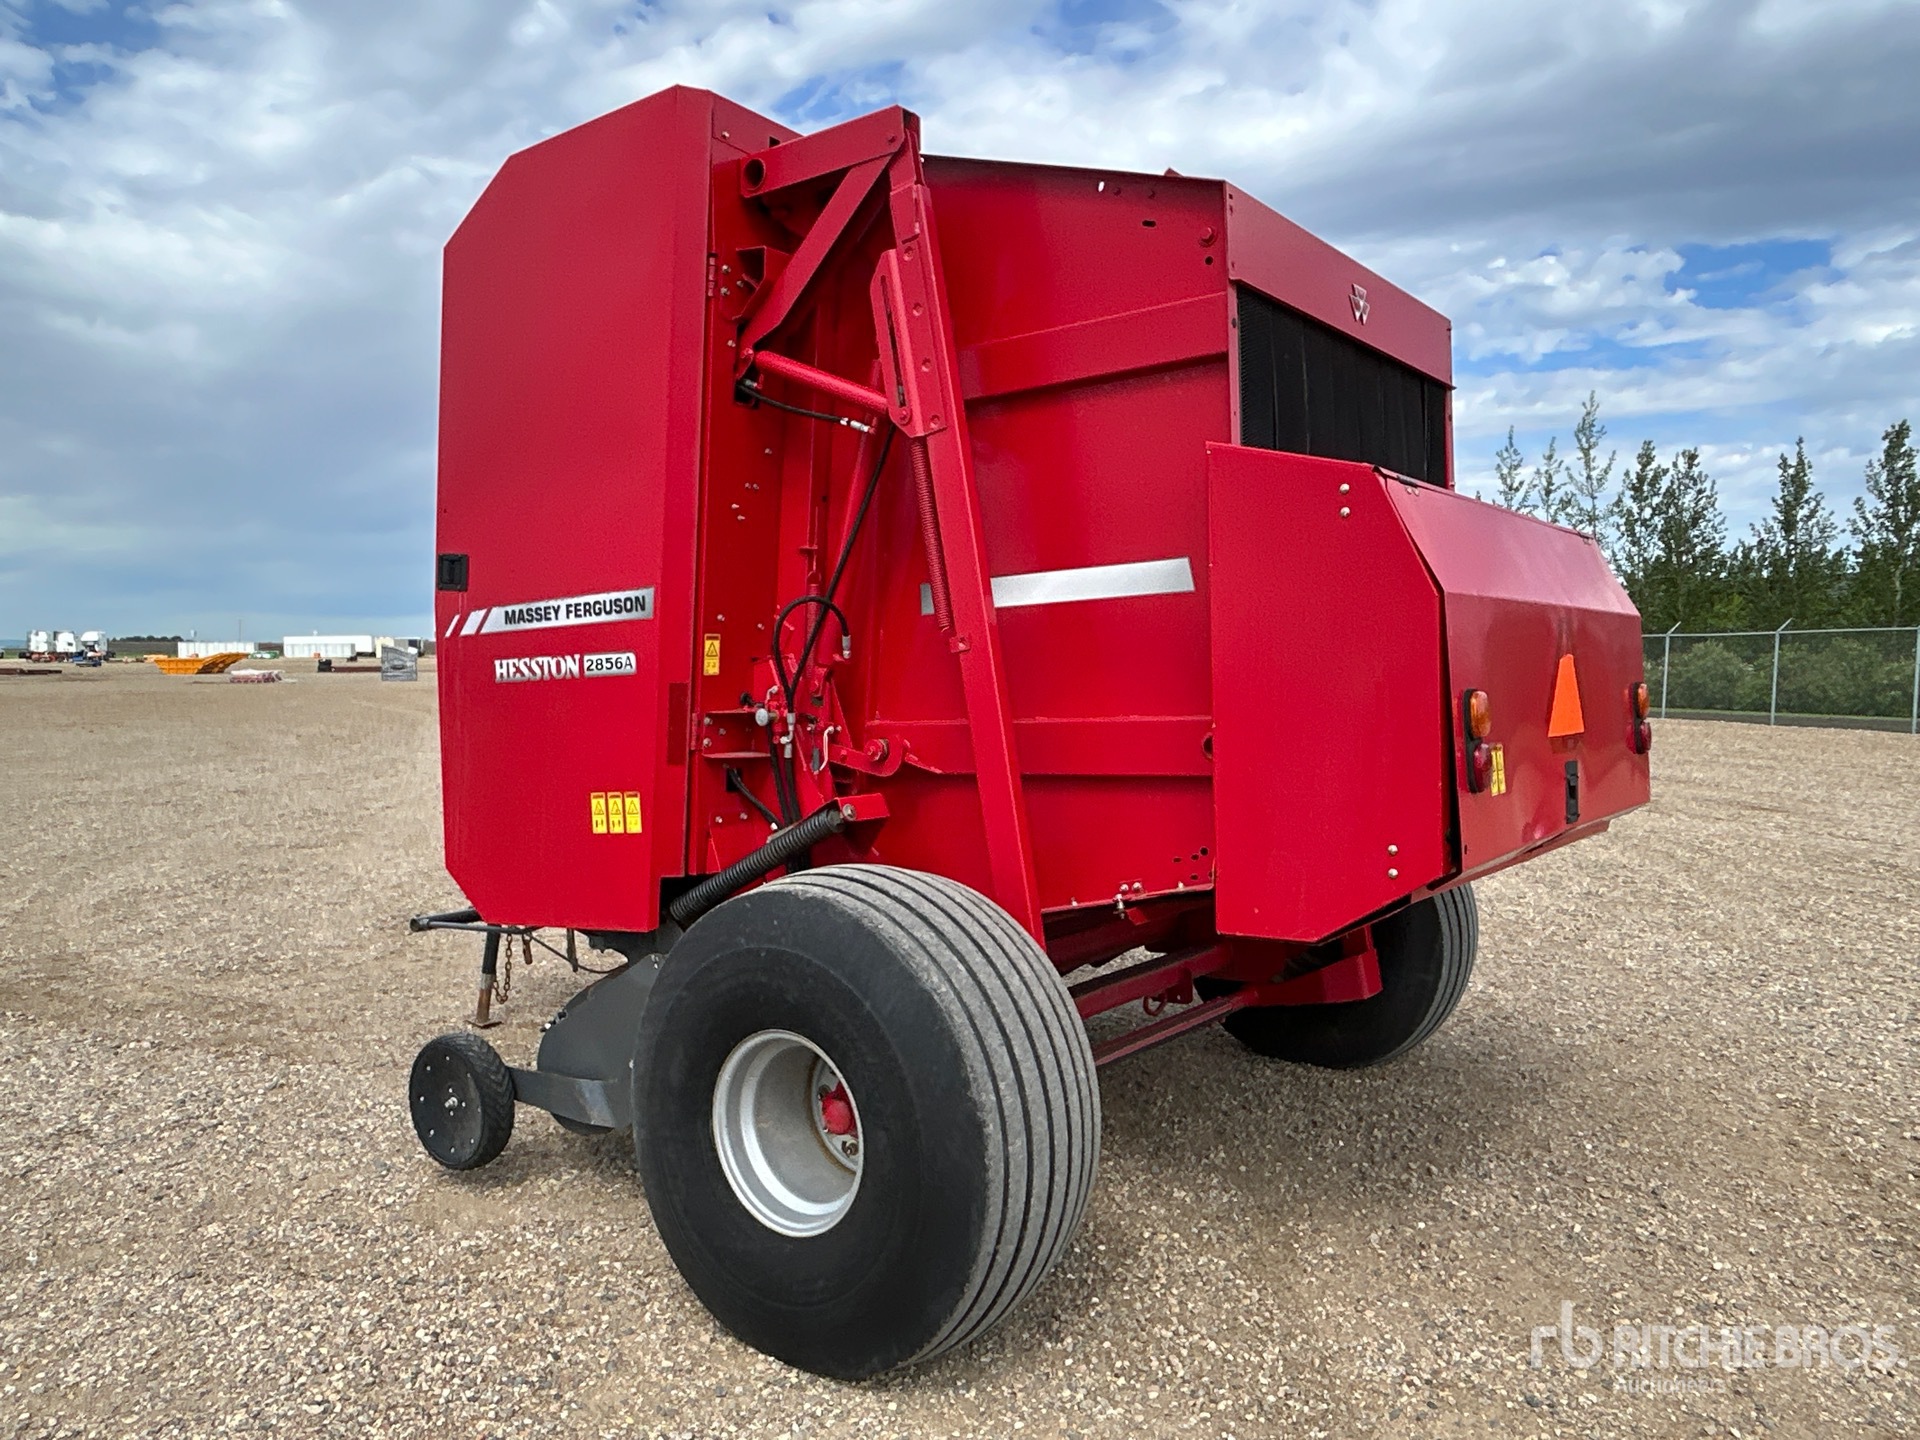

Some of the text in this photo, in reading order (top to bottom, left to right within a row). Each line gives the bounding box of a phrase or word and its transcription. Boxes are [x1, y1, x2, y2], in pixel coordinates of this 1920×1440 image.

[505, 595, 646, 625] MASSEY FERGUSON
[494, 655, 633, 683] HESSTON 2856A
